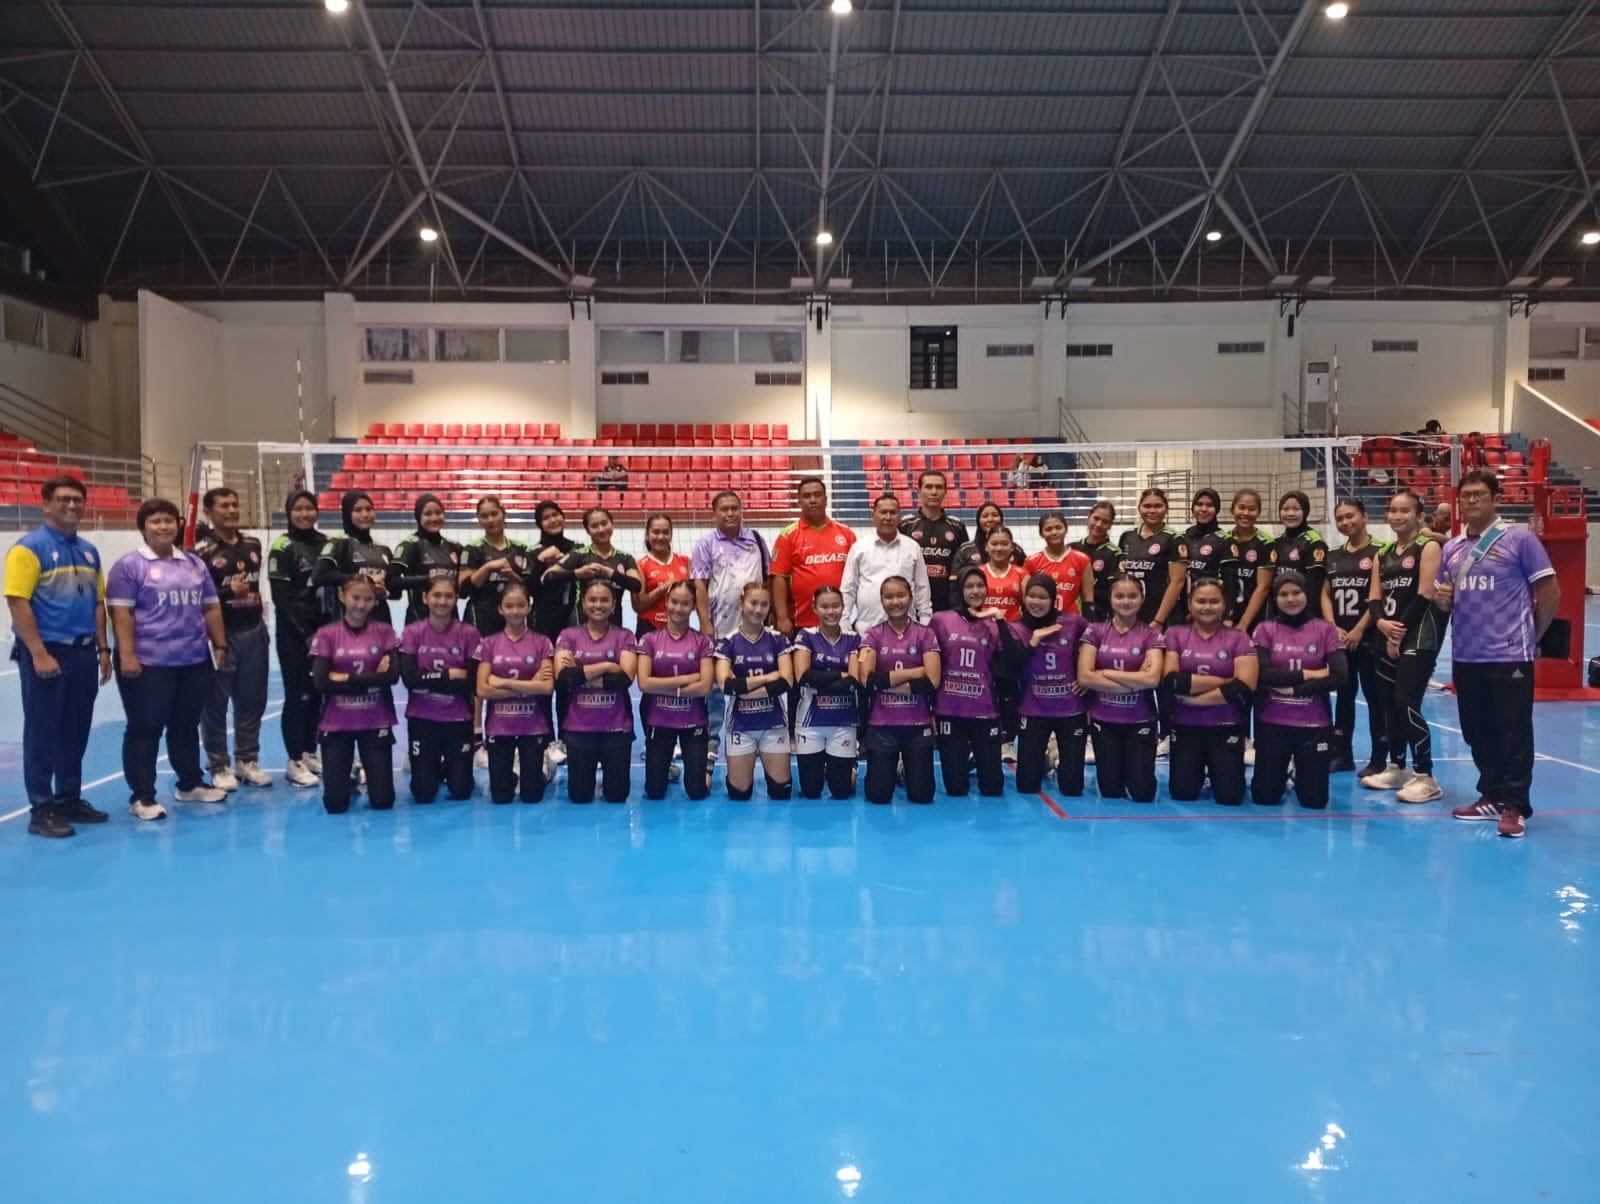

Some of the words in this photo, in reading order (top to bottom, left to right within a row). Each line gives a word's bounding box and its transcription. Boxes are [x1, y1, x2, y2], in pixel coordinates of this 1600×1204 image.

[1334, 588, 1359, 616] 12
[957, 647, 975, 669] 10
[1045, 652, 1056, 670] 9
